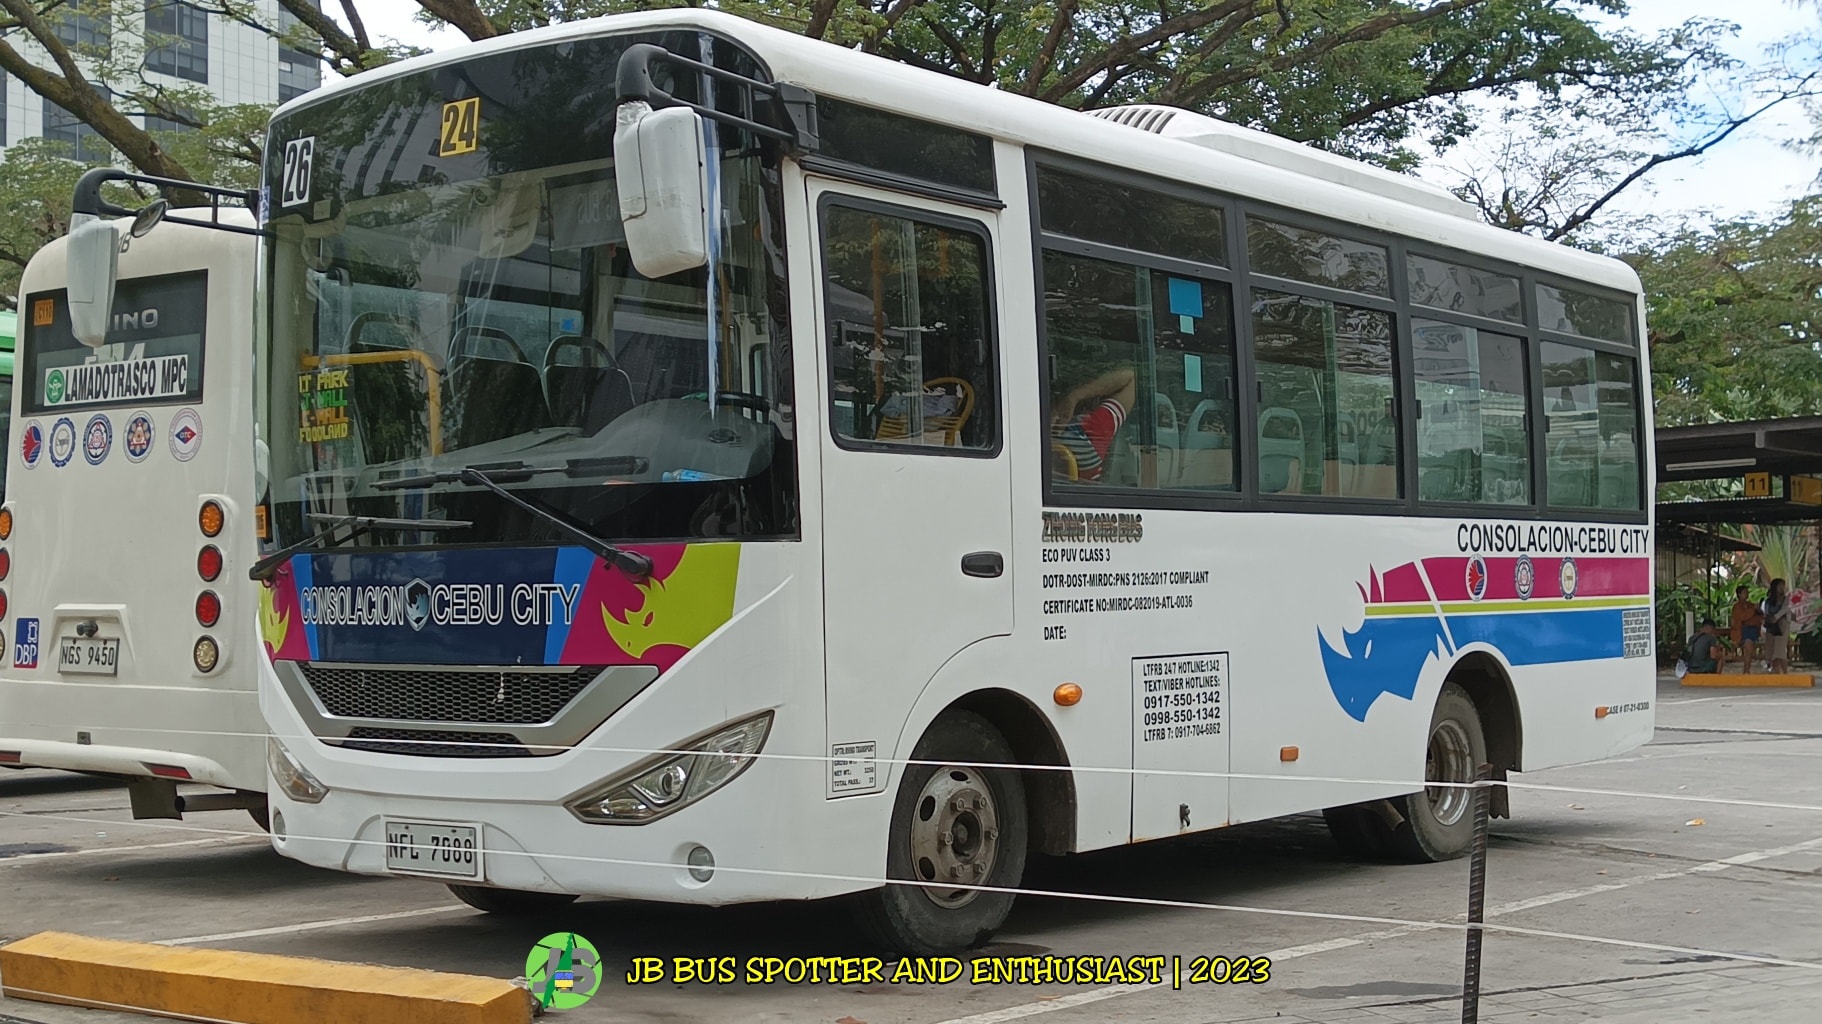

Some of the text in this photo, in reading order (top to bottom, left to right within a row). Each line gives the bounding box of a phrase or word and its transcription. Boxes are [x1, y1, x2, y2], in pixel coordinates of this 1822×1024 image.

[442, 100, 476, 153] 24
[283, 139, 312, 202] 26
[113, 308, 158, 331] INO
[64, 360, 156, 402] LAMADOTRASCO
[161, 356, 188, 394] MPC
[299, 369, 349, 392] IT PARK
[299, 422, 348, 443] FOODLAND
[1749, 478, 1765, 491] 11
[1457, 523, 1649, 554] CONSOLACION-CEBU CITY
[1042, 548, 1111, 563] ECO PUV CLASS 3
[1169, 571, 1209, 585] COMPLIANT
[300, 583, 580, 626] CONSOLACION CEBU CITY
[1043, 598, 1094, 615] CERTIFICATE
[1043, 626, 1067, 641] DATE:
[15, 644, 37, 666] DBP
[61, 646, 115, 666] NGS 9450
[1143, 663, 1162, 677] LTFRB
[1144, 691, 1220, 709] 0917-550-1342
[1144, 707, 1220, 726] 0998-550-1342
[1144, 728, 1165, 742] LTFRB
[1167, 727, 1174, 739] 7:
[388, 833, 419, 859] NFL
